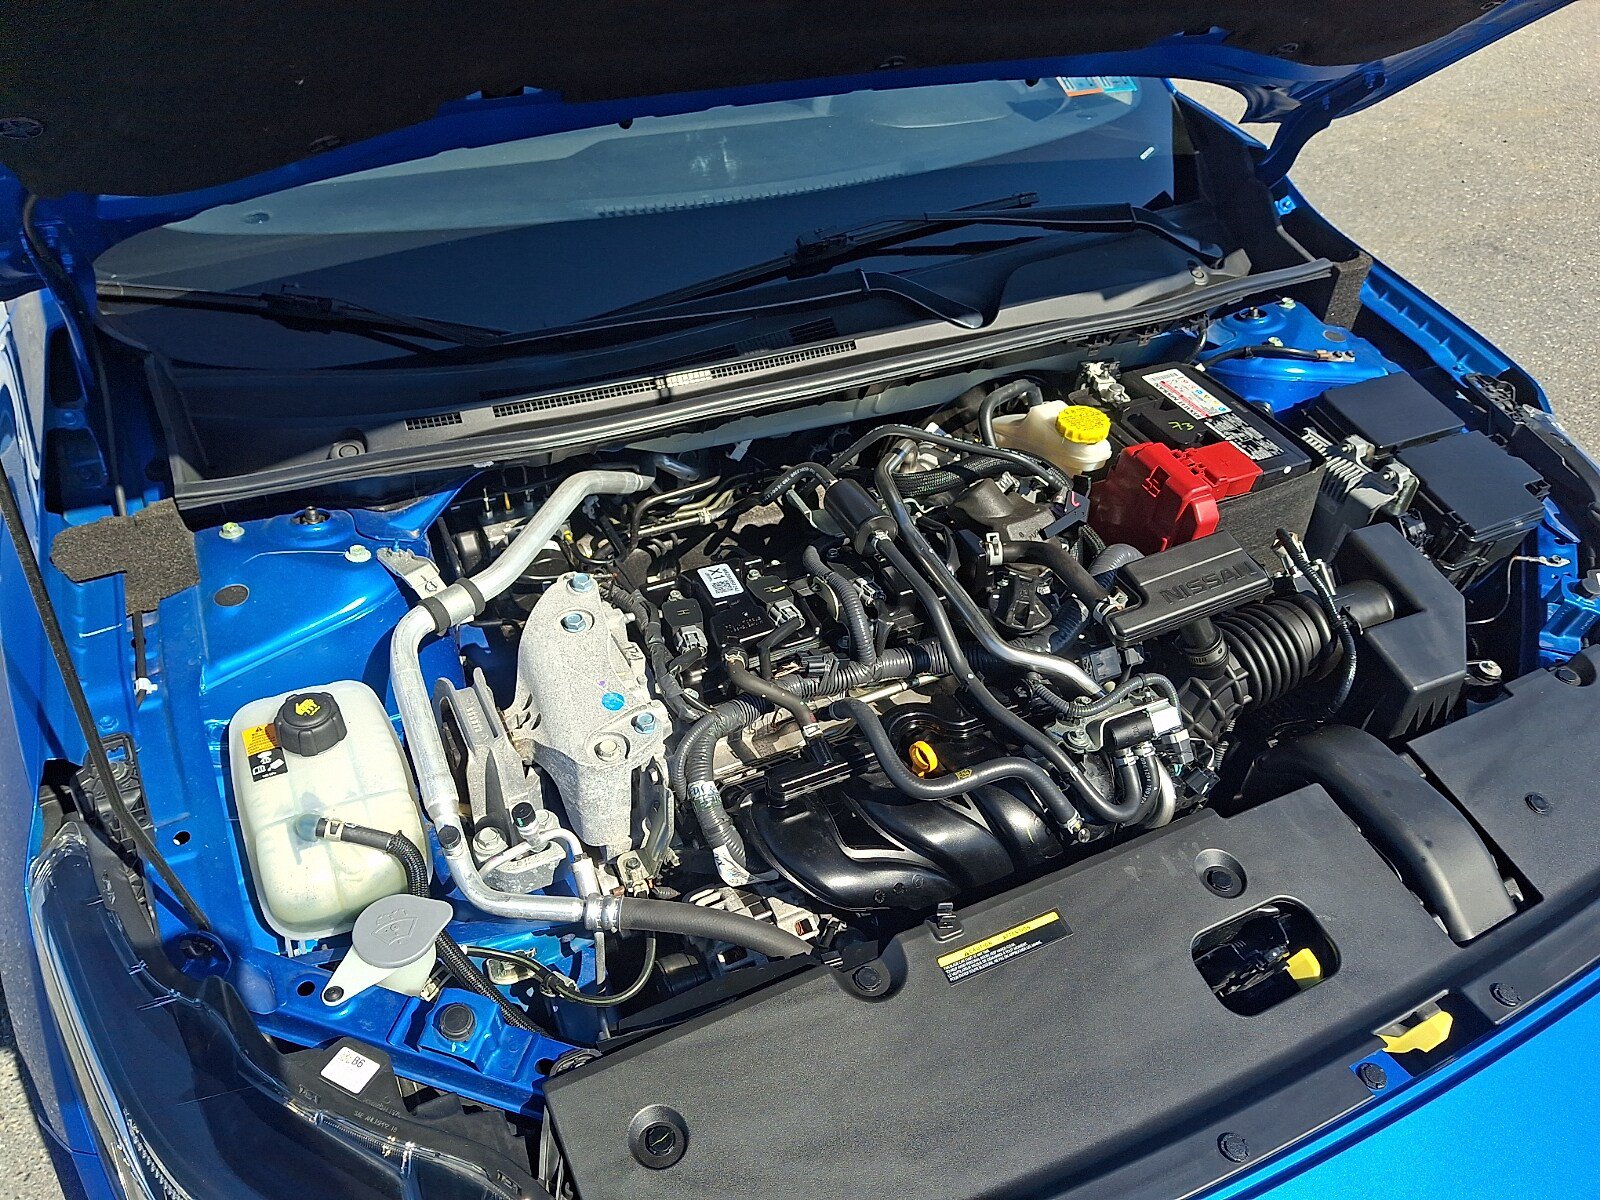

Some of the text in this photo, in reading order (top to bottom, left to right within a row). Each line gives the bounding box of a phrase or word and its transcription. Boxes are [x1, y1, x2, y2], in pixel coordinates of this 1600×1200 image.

[1160, 562, 1258, 605] NISSAN
[969, 926, 1031, 954] CAUTION ATTENTION
